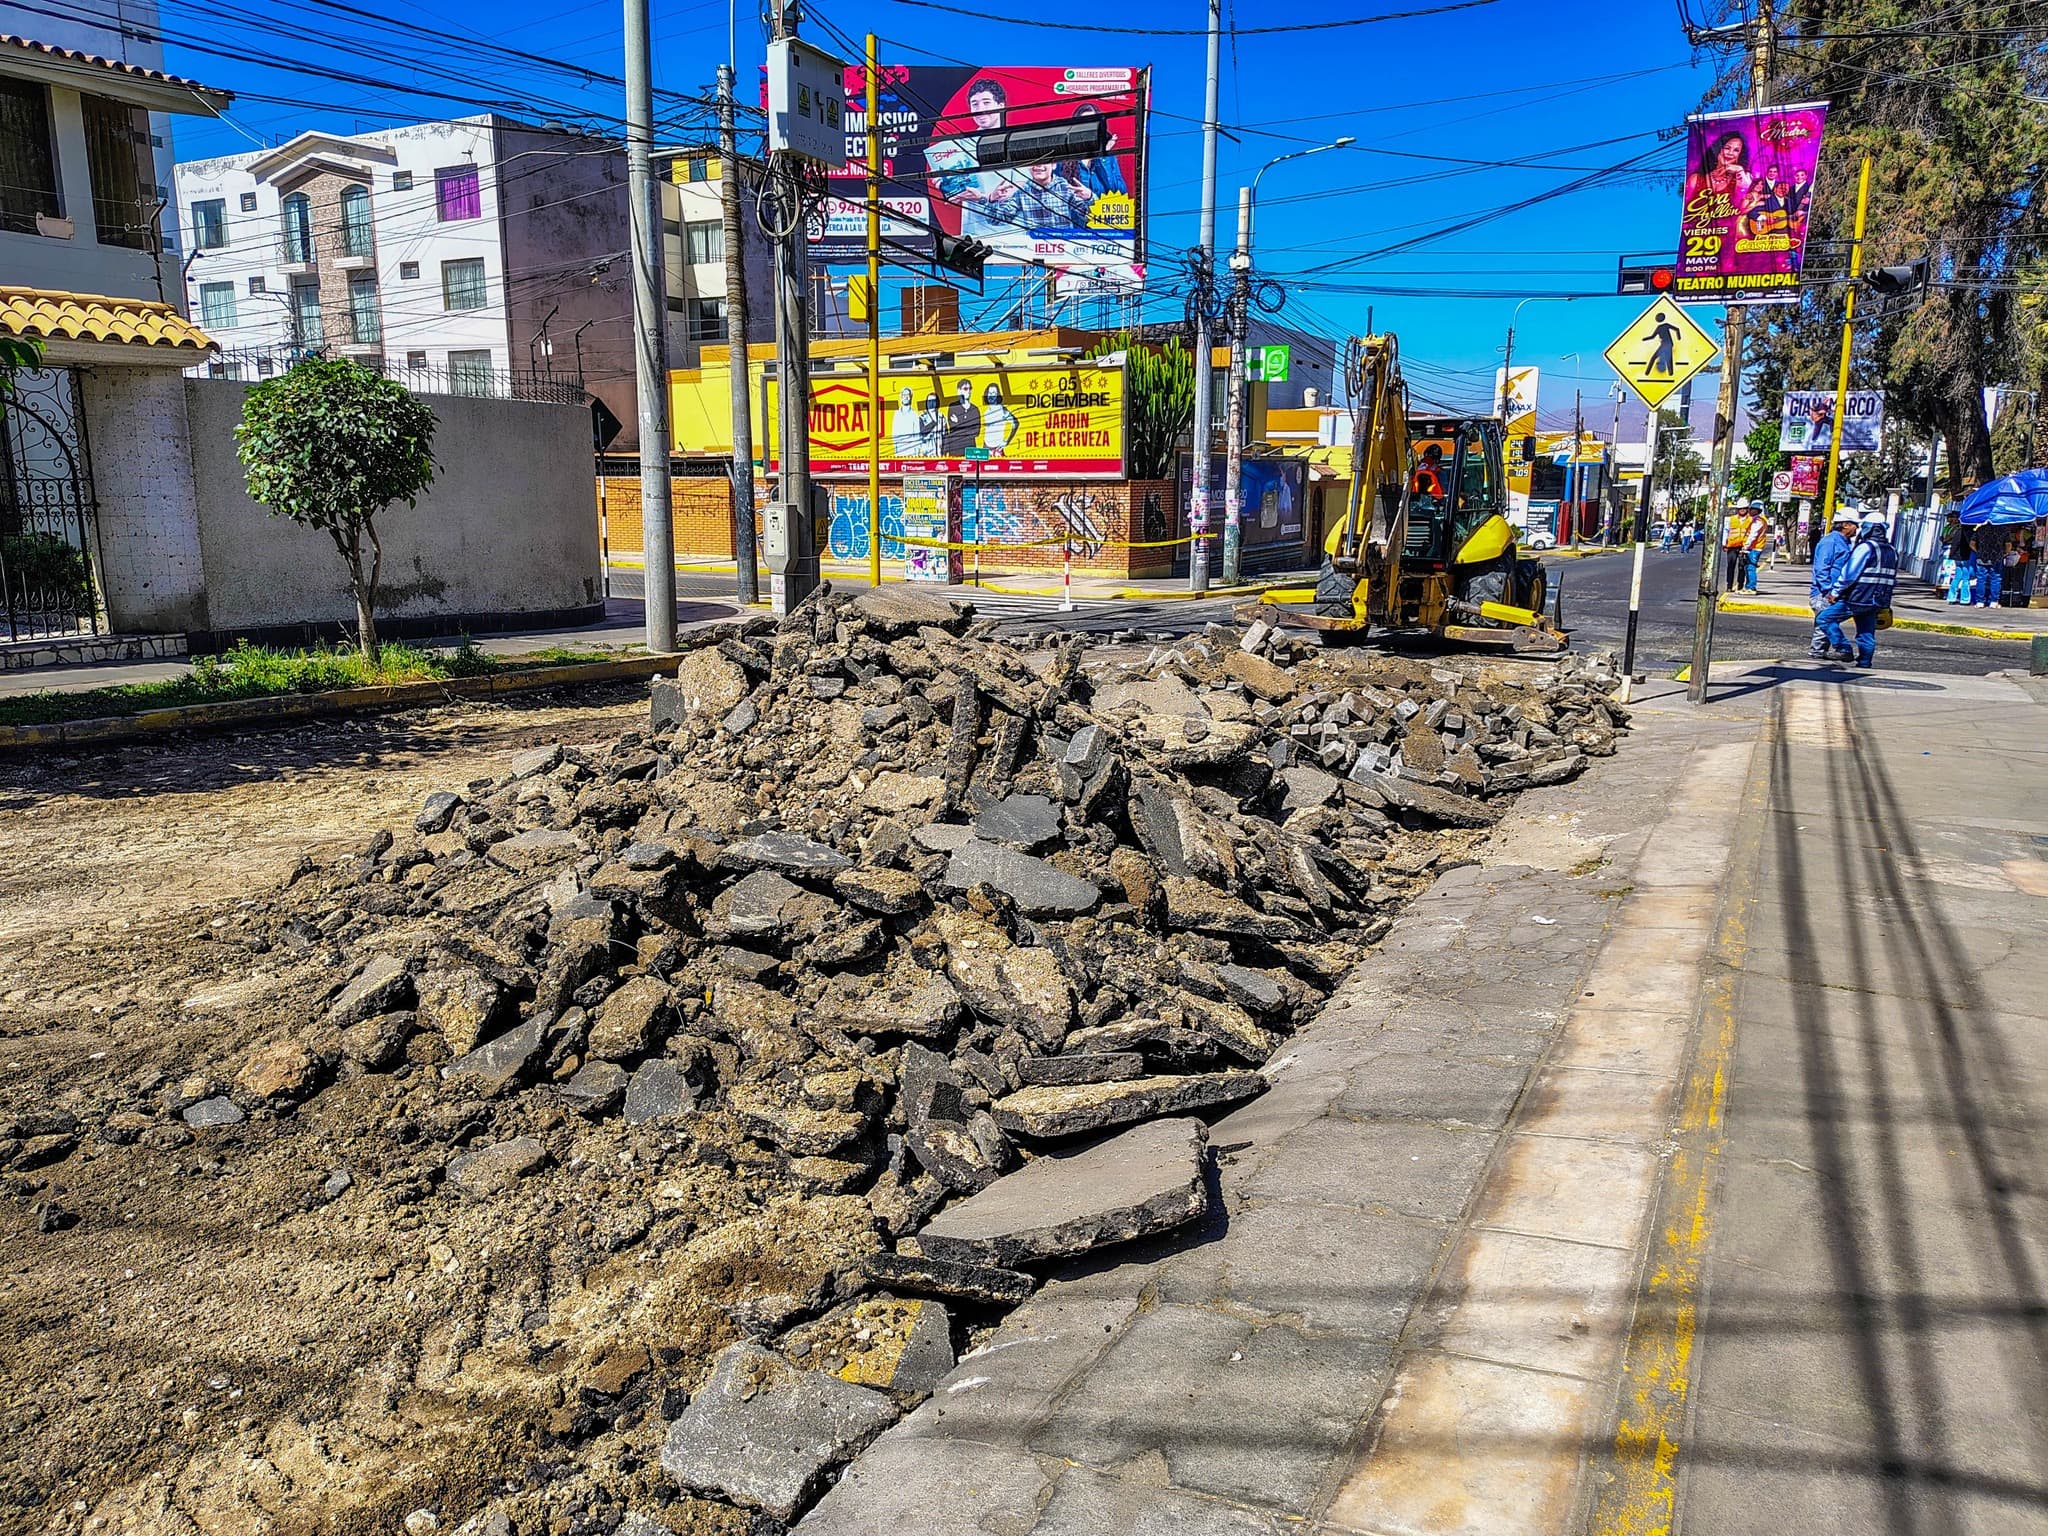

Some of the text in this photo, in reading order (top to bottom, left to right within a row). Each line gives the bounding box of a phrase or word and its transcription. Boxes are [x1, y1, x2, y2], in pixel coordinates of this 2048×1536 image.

[1102, 204, 1129, 213] EN SOLO
[1104, 215, 1129, 224] MESES
[1684, 227, 1728, 236] VIERNES
[1035, 244, 1064, 253] IELTS
[1091, 244, 1122, 255] TOEFL
[1686, 236, 1721, 256] 29
[1686, 257, 1718, 265] MAYO
[1677, 277, 1723, 290] TEATRO
[1059, 377, 1077, 391] 05
[1026, 392, 1110, 408] DICIEMBRE
[1026, 431, 1110, 447] DE LA CERVEZA
